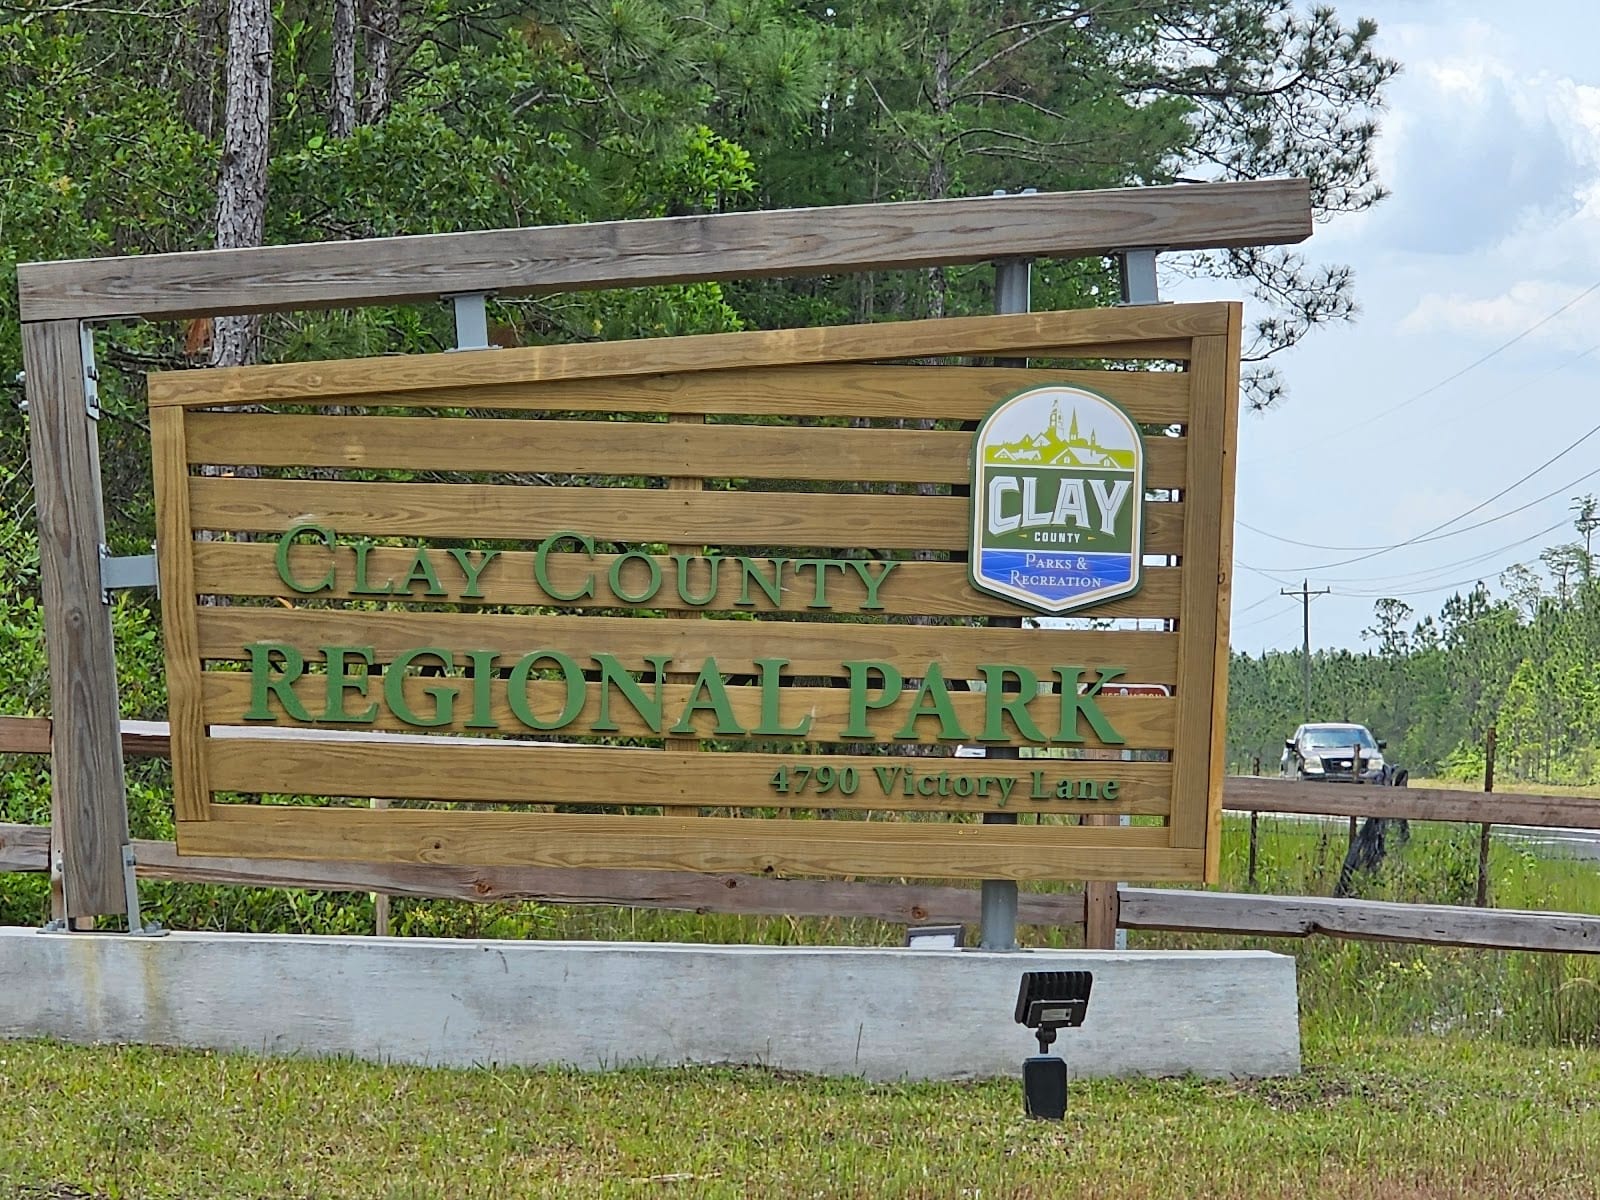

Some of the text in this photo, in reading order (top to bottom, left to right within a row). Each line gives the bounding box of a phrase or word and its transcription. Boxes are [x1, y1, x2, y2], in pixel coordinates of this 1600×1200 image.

[989, 476, 1133, 536] CLAY
[1034, 531, 1081, 544] COUNTY
[276, 524, 901, 610] CLAY COUNTY
[1010, 570, 1102, 588] RECREATION
[1025, 552, 1088, 570] PARKS &
[243, 643, 1127, 744] REGIONAL PARK
[769, 764, 1121, 806] 4790 Victory Lane
